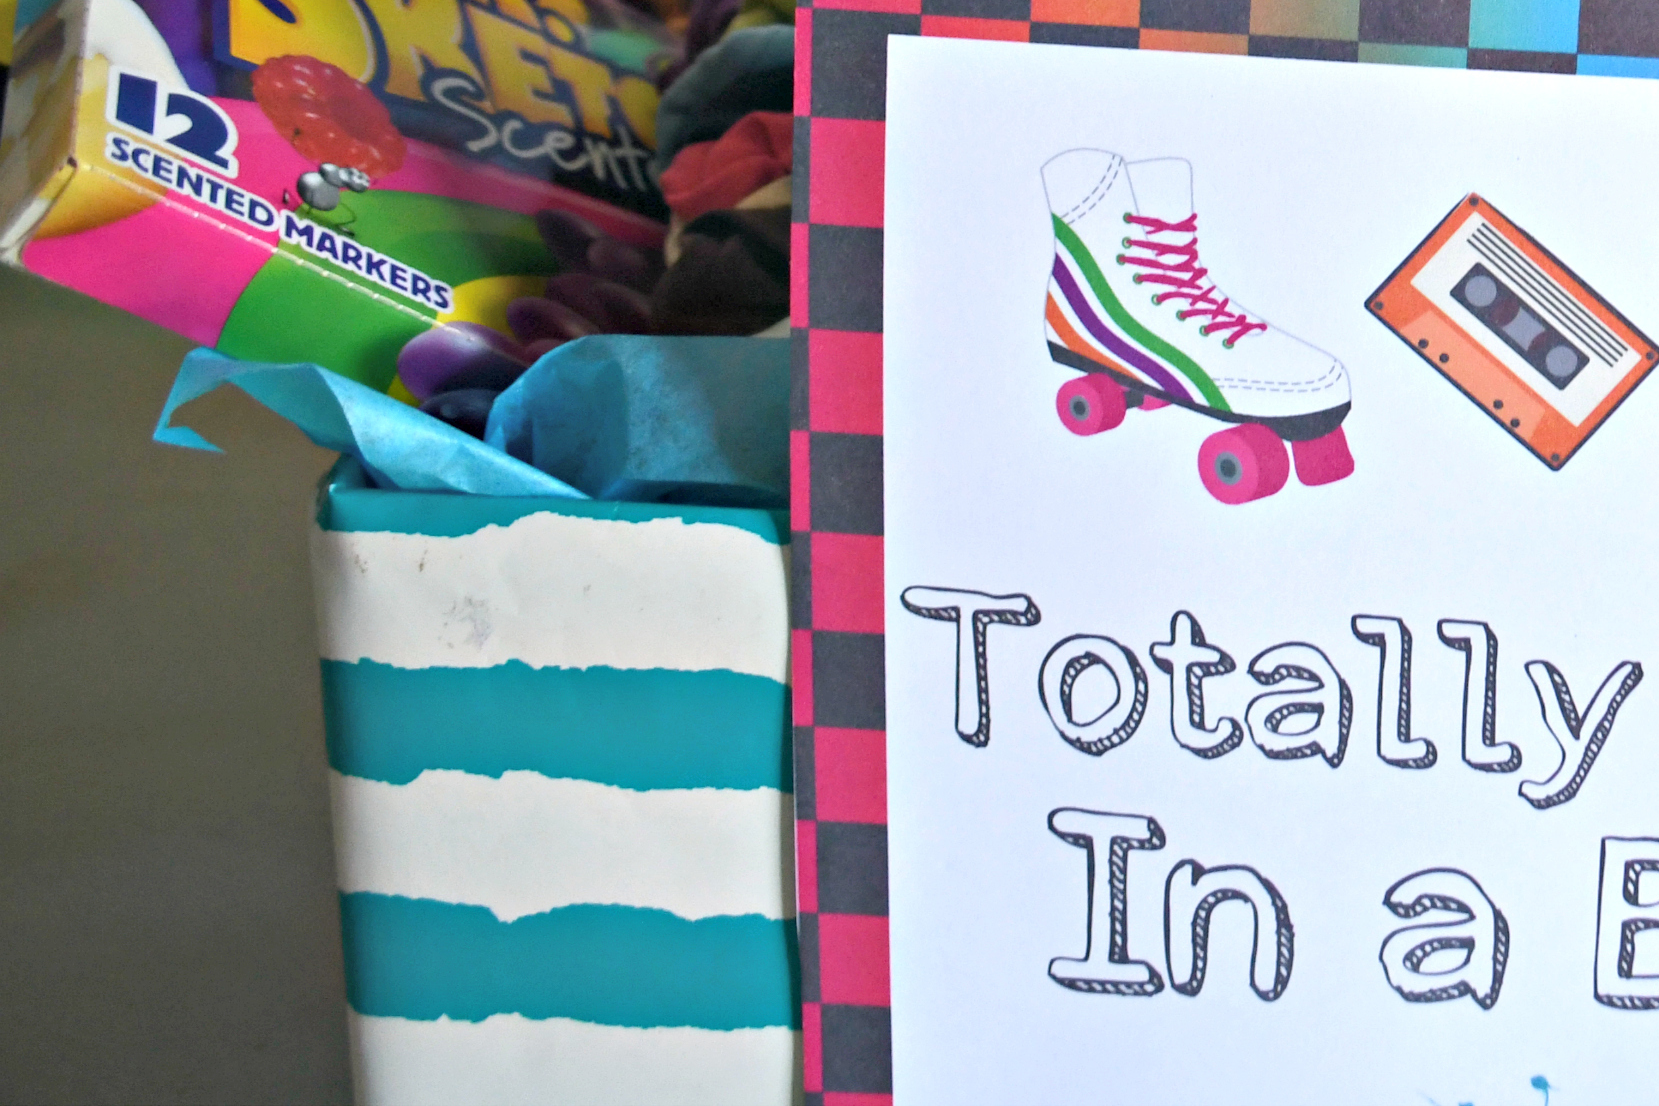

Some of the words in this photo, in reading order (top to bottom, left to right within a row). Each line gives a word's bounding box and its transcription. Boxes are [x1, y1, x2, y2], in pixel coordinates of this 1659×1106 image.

[115, 71, 230, 170] 12
[430, 76, 660, 192] Scent
[110, 135, 276, 229] SCENTED
[284, 214, 451, 310] MARKERS
[900, 585, 1643, 810] Totally
[1047, 807, 1295, 1002] In
[1378, 866, 1511, 1010] a
